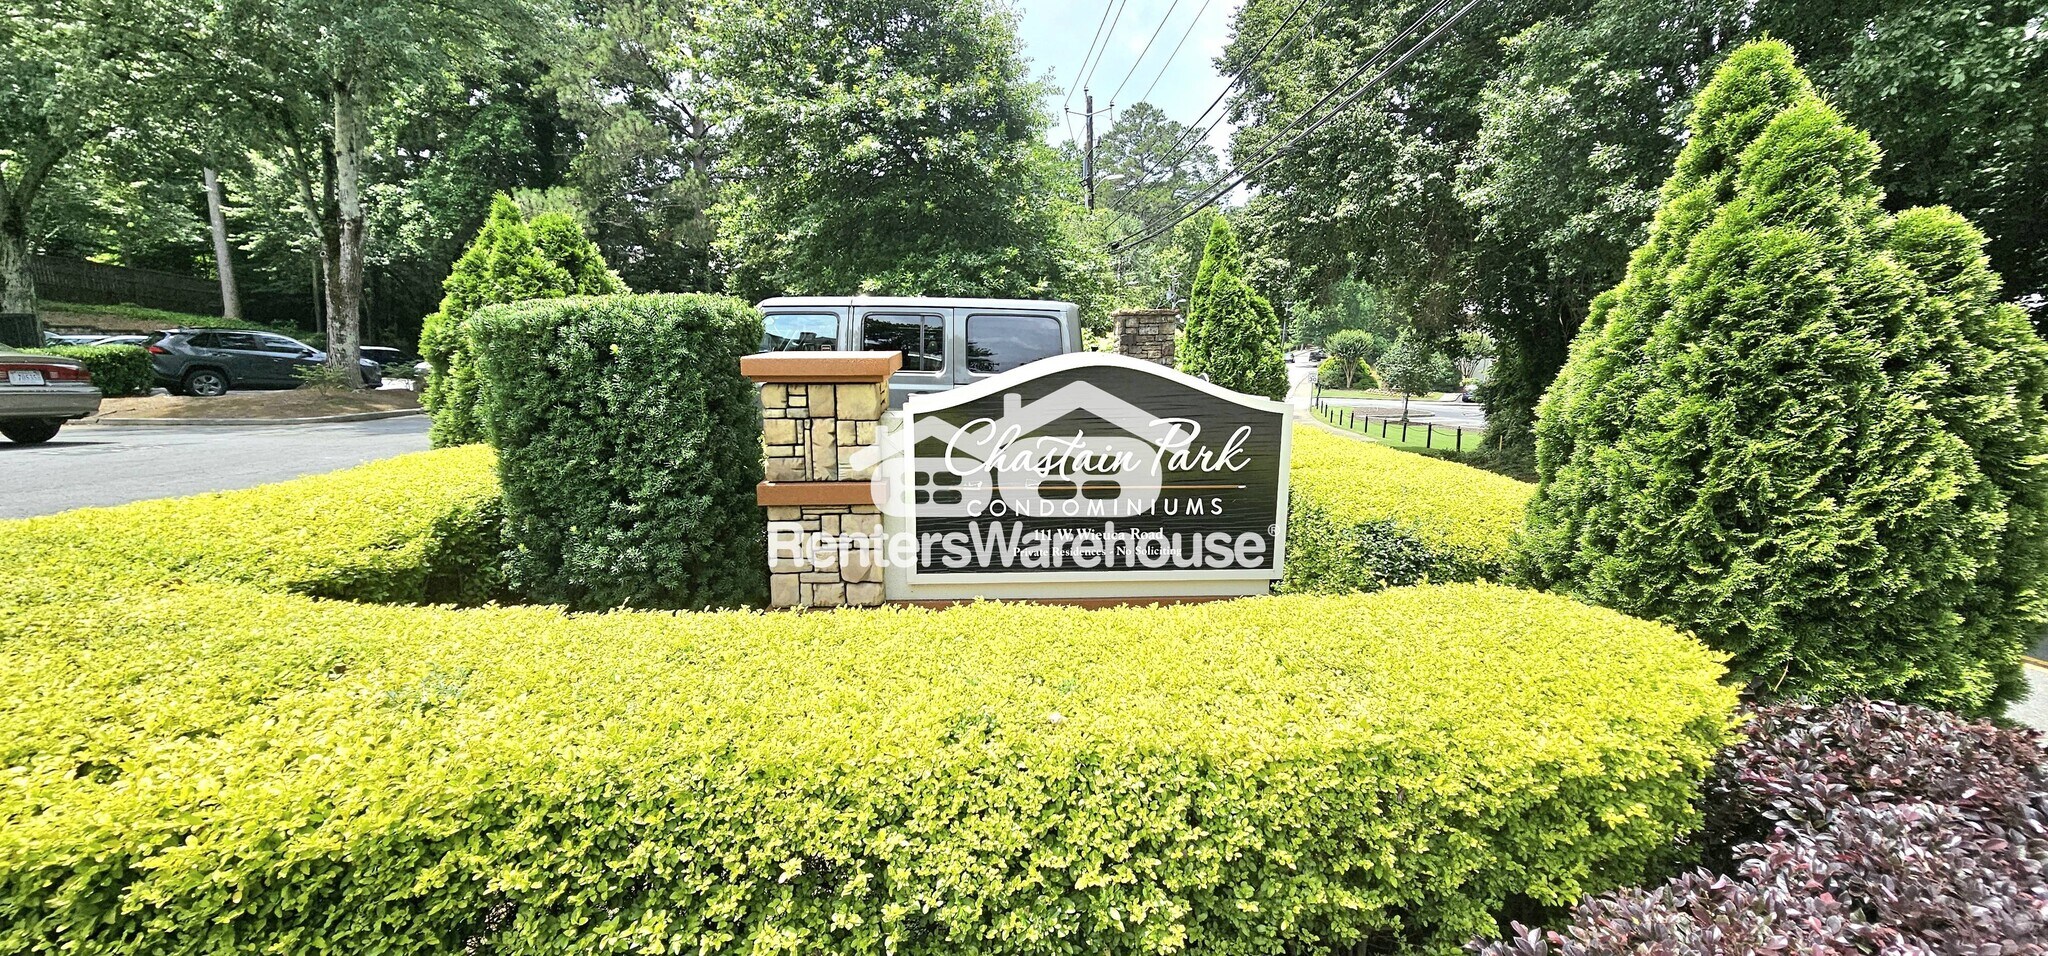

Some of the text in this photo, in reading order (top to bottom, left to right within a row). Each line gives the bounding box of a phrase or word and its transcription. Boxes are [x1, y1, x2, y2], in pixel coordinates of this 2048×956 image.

[944, 417, 1252, 481] Chastain Park
[966, 497, 1223, 516] CONDOMINIUMS
[1033, 528, 1052, 541] 111
[1076, 528, 1125, 541] Wieuca
[1130, 526, 1164, 540] Road
[1013, 547, 1049, 557] Private
[1052, 546, 1106, 556] Residences
[1116, 546, 1132, 556] No
[1135, 546, 1182, 557] Soliciting
